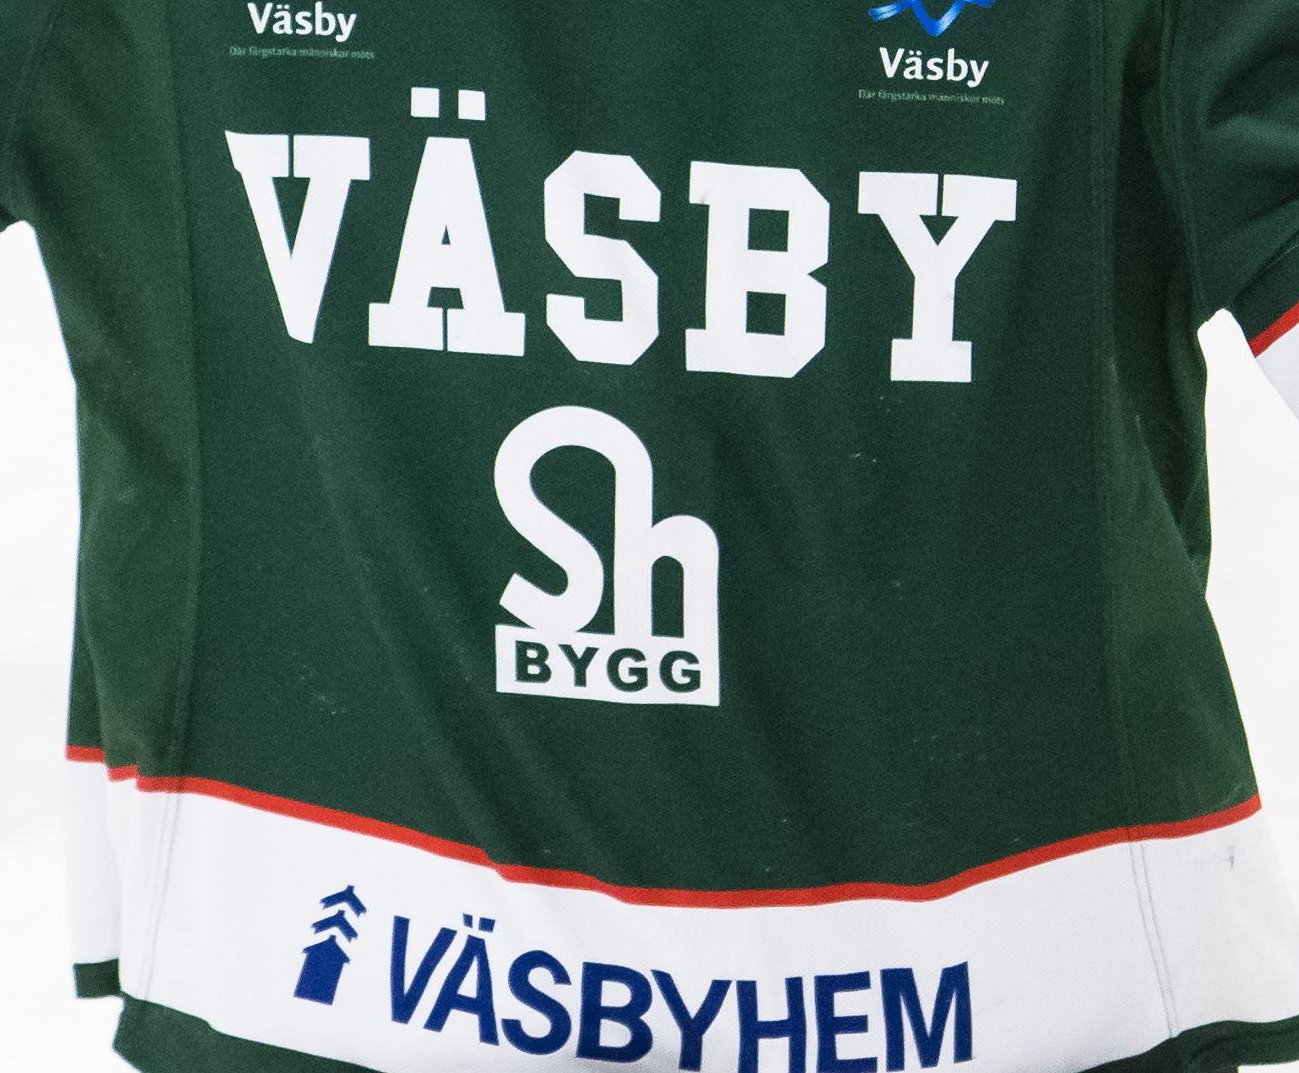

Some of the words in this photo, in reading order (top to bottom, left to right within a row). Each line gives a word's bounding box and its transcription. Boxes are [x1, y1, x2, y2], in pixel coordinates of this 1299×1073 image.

[247, 0, 357, 43] Väsby
[879, 46, 989, 88] Väsby
[224, 85, 1018, 384] VÄSBY
[494, 405, 720, 638] Sh
[514, 639, 702, 694] BYGG
[389, 913, 975, 1073] VÄSBYHEM
